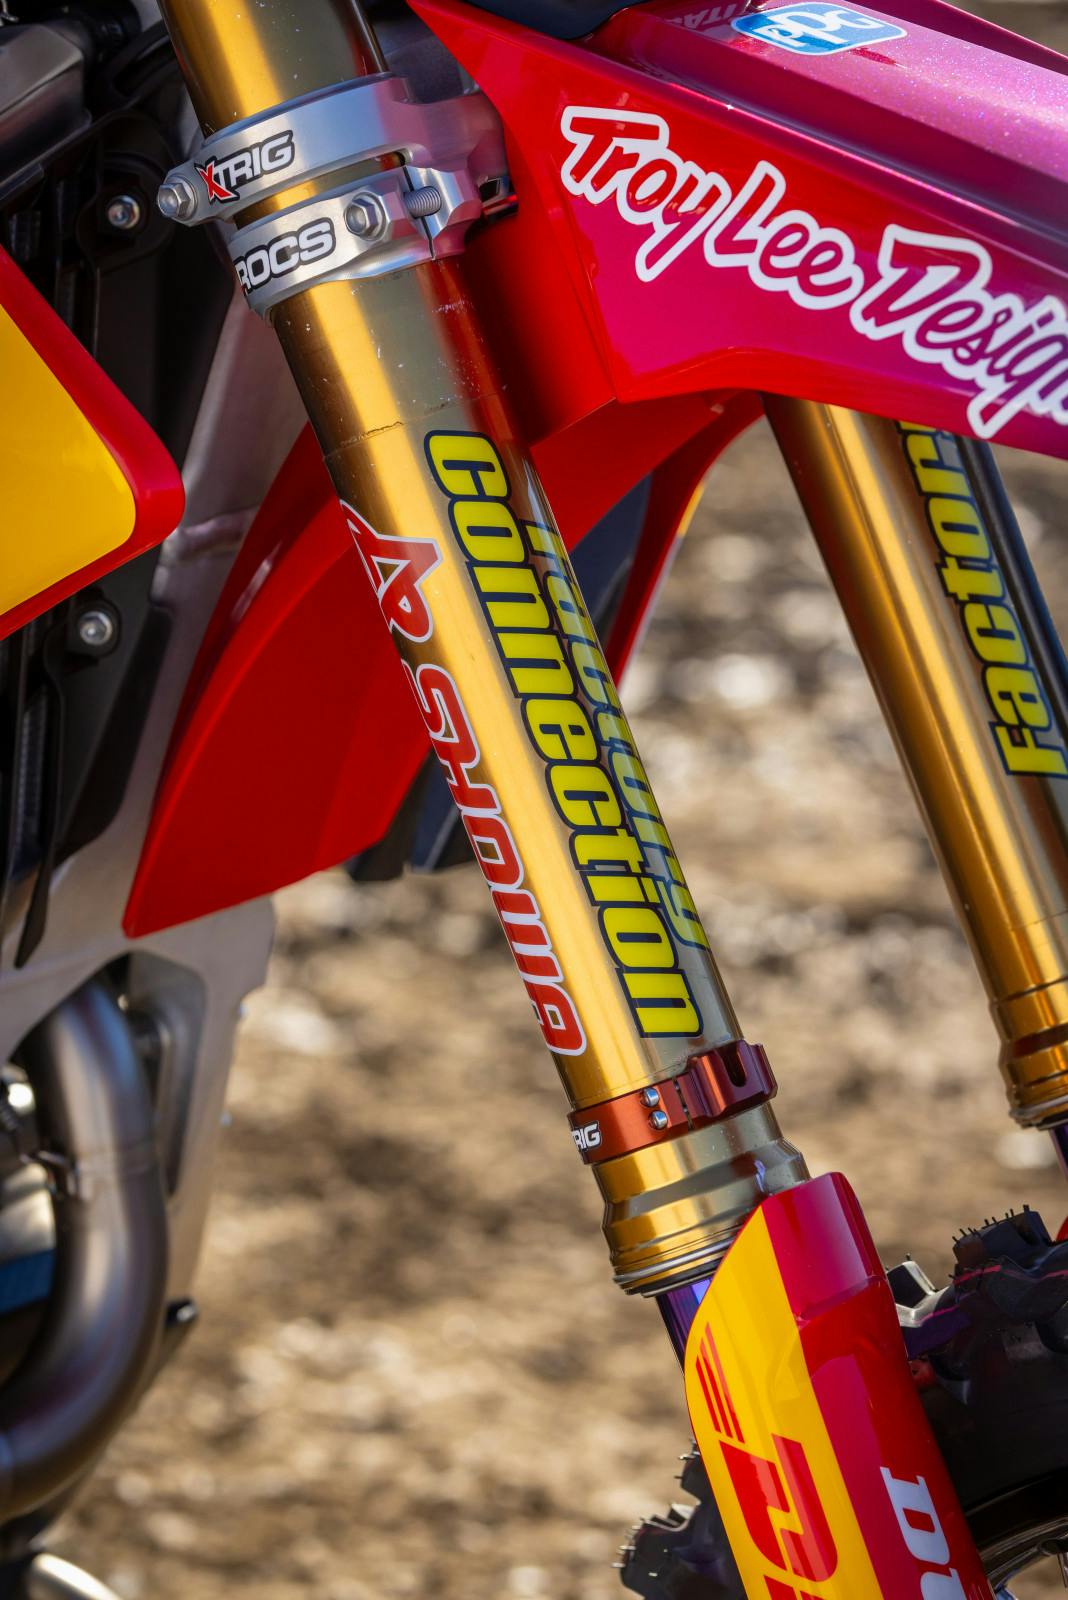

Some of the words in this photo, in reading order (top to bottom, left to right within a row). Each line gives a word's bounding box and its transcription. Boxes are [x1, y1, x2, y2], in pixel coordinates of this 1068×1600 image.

[751, 8, 885, 48] PPG
[195, 131, 294, 204] XTRIG
[561, 106, 732, 282] Troy
[704, 160, 864, 309] Lee
[893, 421, 1068, 777] Factor
